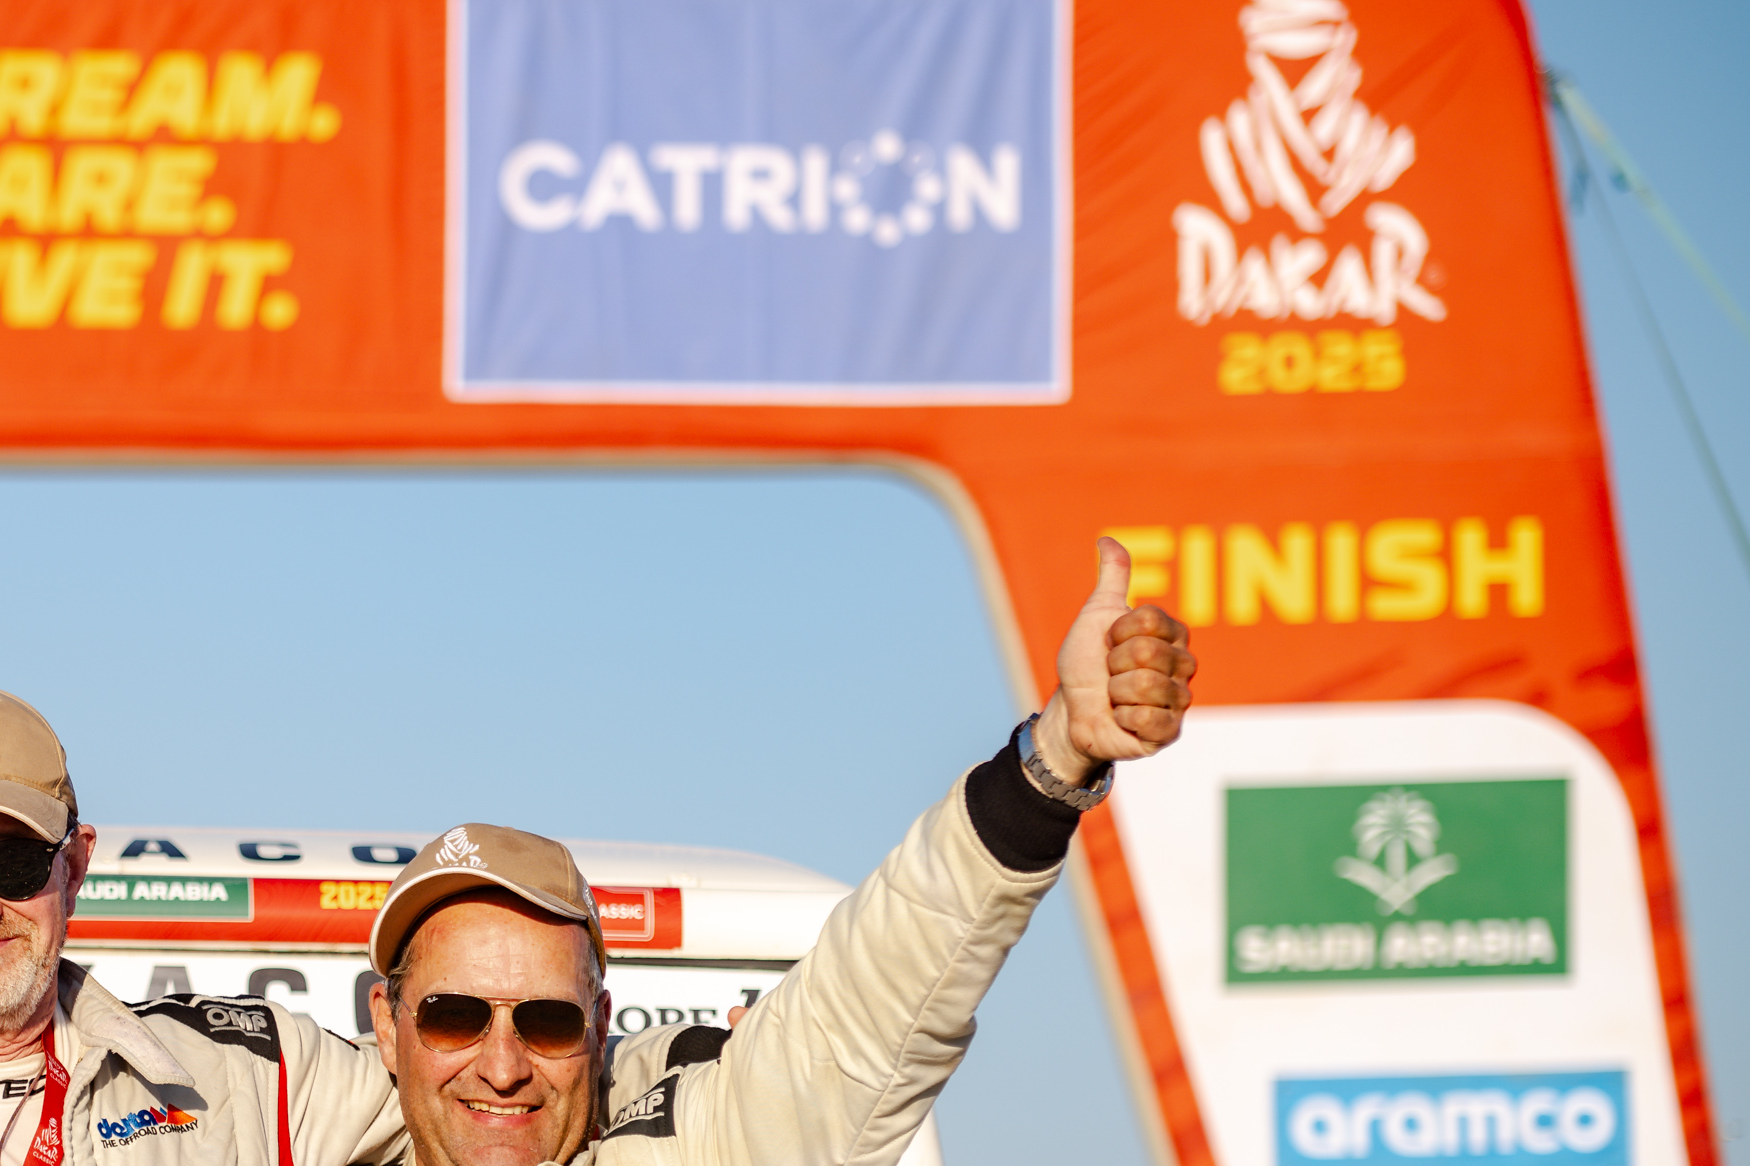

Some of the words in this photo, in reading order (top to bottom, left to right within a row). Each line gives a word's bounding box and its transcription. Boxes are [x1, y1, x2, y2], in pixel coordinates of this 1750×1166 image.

[498, 129, 1021, 249] CATRION
[160, 238, 300, 331] IT.
[1172, 202, 1447, 325] DAKAR
[1217, 330, 1405, 395] 2025
[1100, 516, 1544, 628] FINISH
[132, 881, 228, 902] ARABIA
[599, 903, 646, 920] ASSIC
[1234, 921, 1377, 973] SAUDI
[1380, 916, 1558, 969] ARABIA
[206, 1008, 267, 1032] OMP
[34, 1136, 59, 1162] DAKAR
[101, 1139, 118, 1149] THE
[119, 1126, 158, 1146] OFFROAD
[158, 1119, 199, 1135] COMPANY
[1287, 1086, 1616, 1160] aramco
[33, 1150, 55, 1166] CLASSIC
